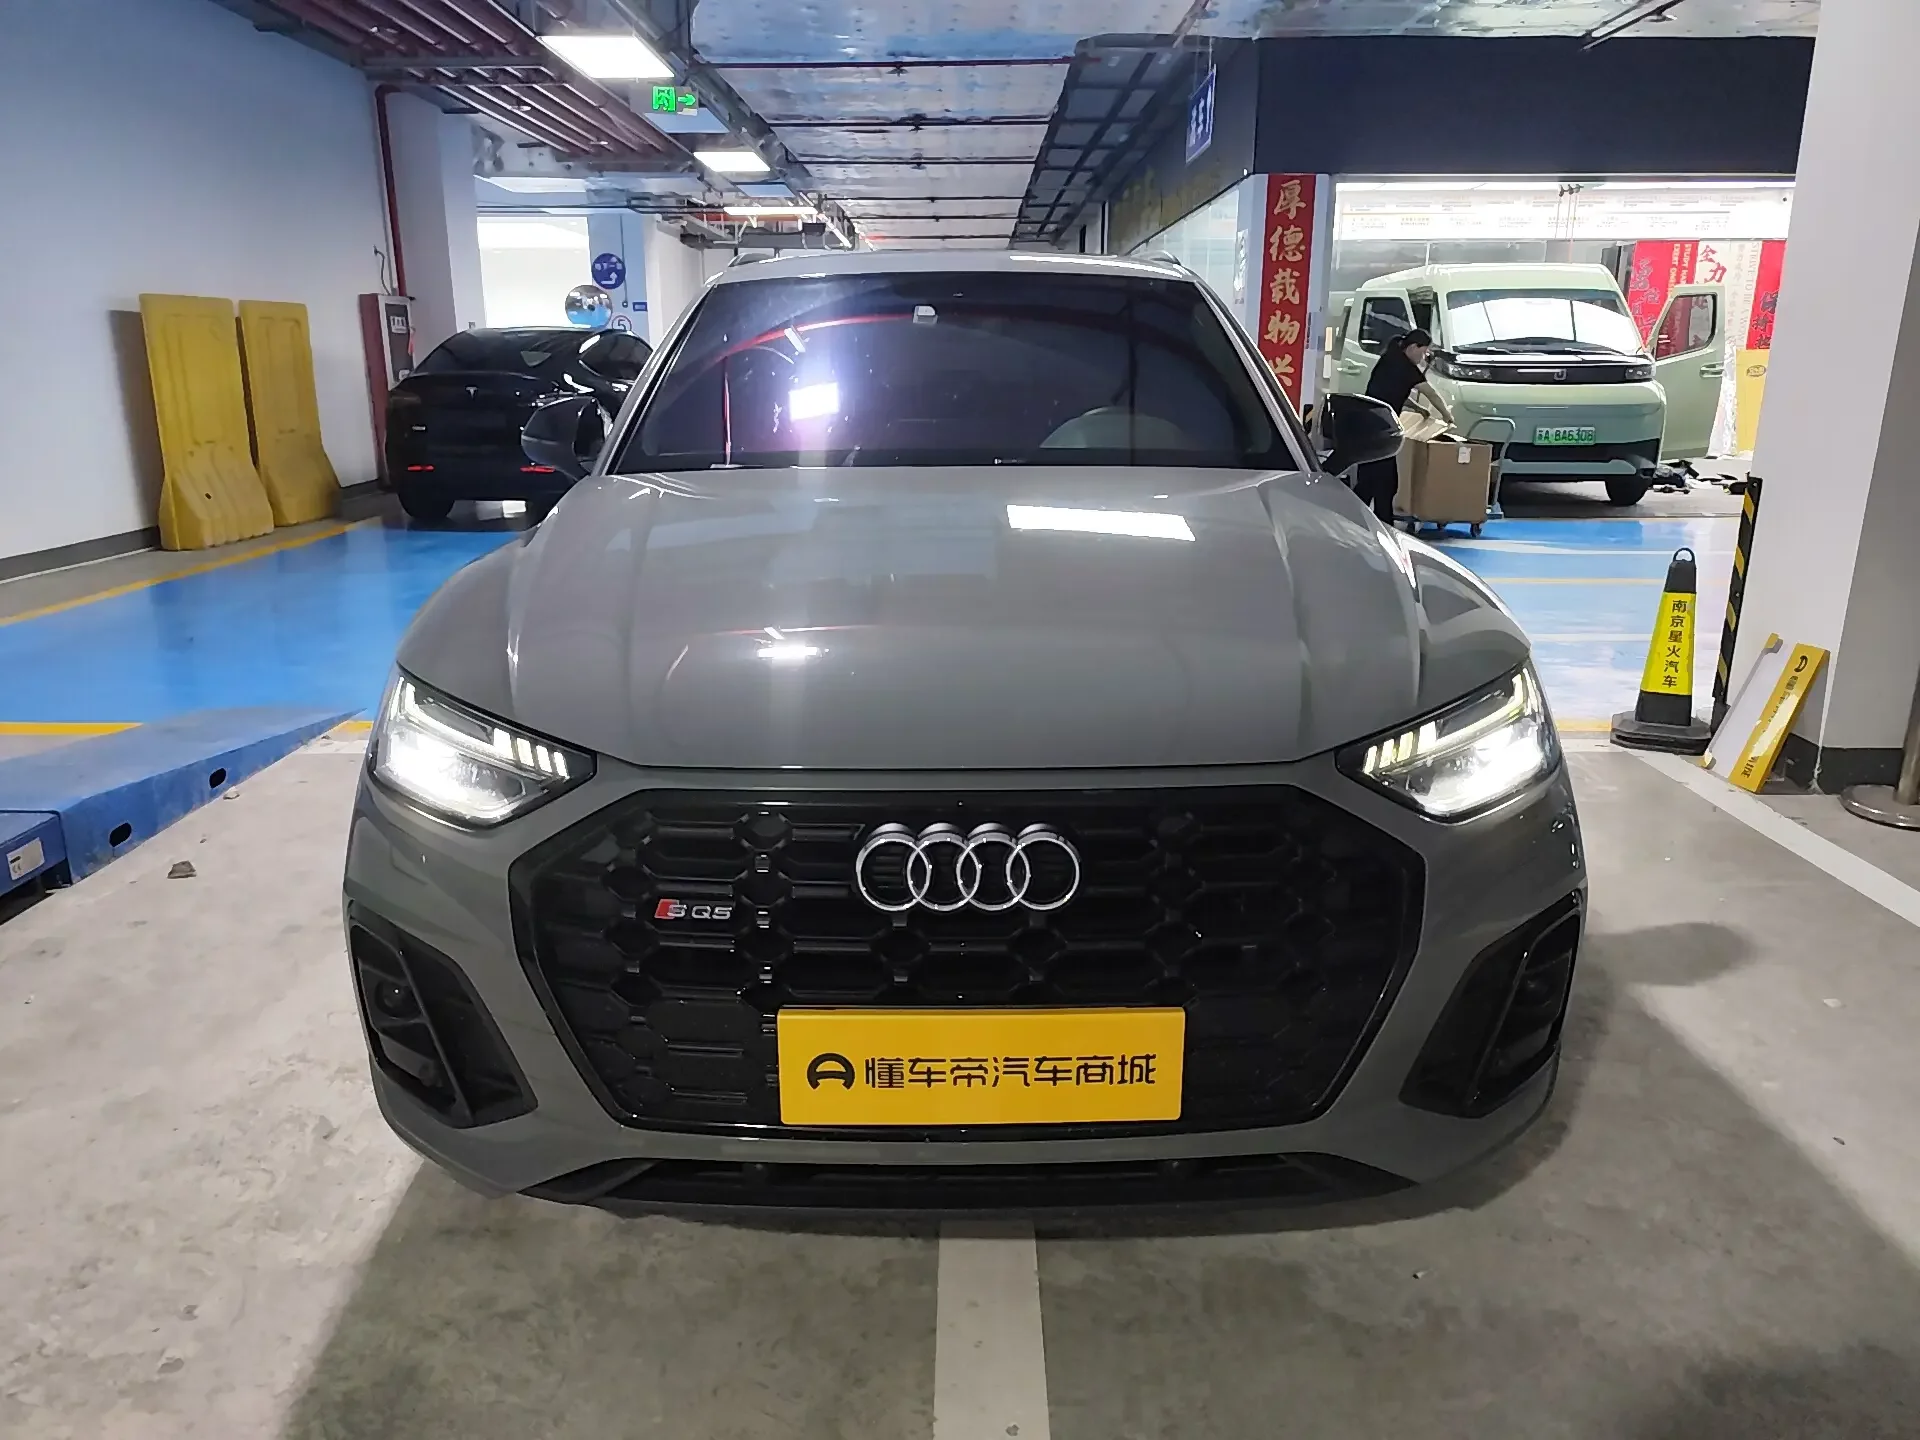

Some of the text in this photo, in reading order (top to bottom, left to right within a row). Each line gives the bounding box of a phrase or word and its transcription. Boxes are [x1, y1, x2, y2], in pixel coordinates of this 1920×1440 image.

[1699, 244, 1728, 284] 全力
[1661, 599, 1688, 688] 南京星火汽车
[864, 1053, 1157, 1089] 懂车帝汽车商城
